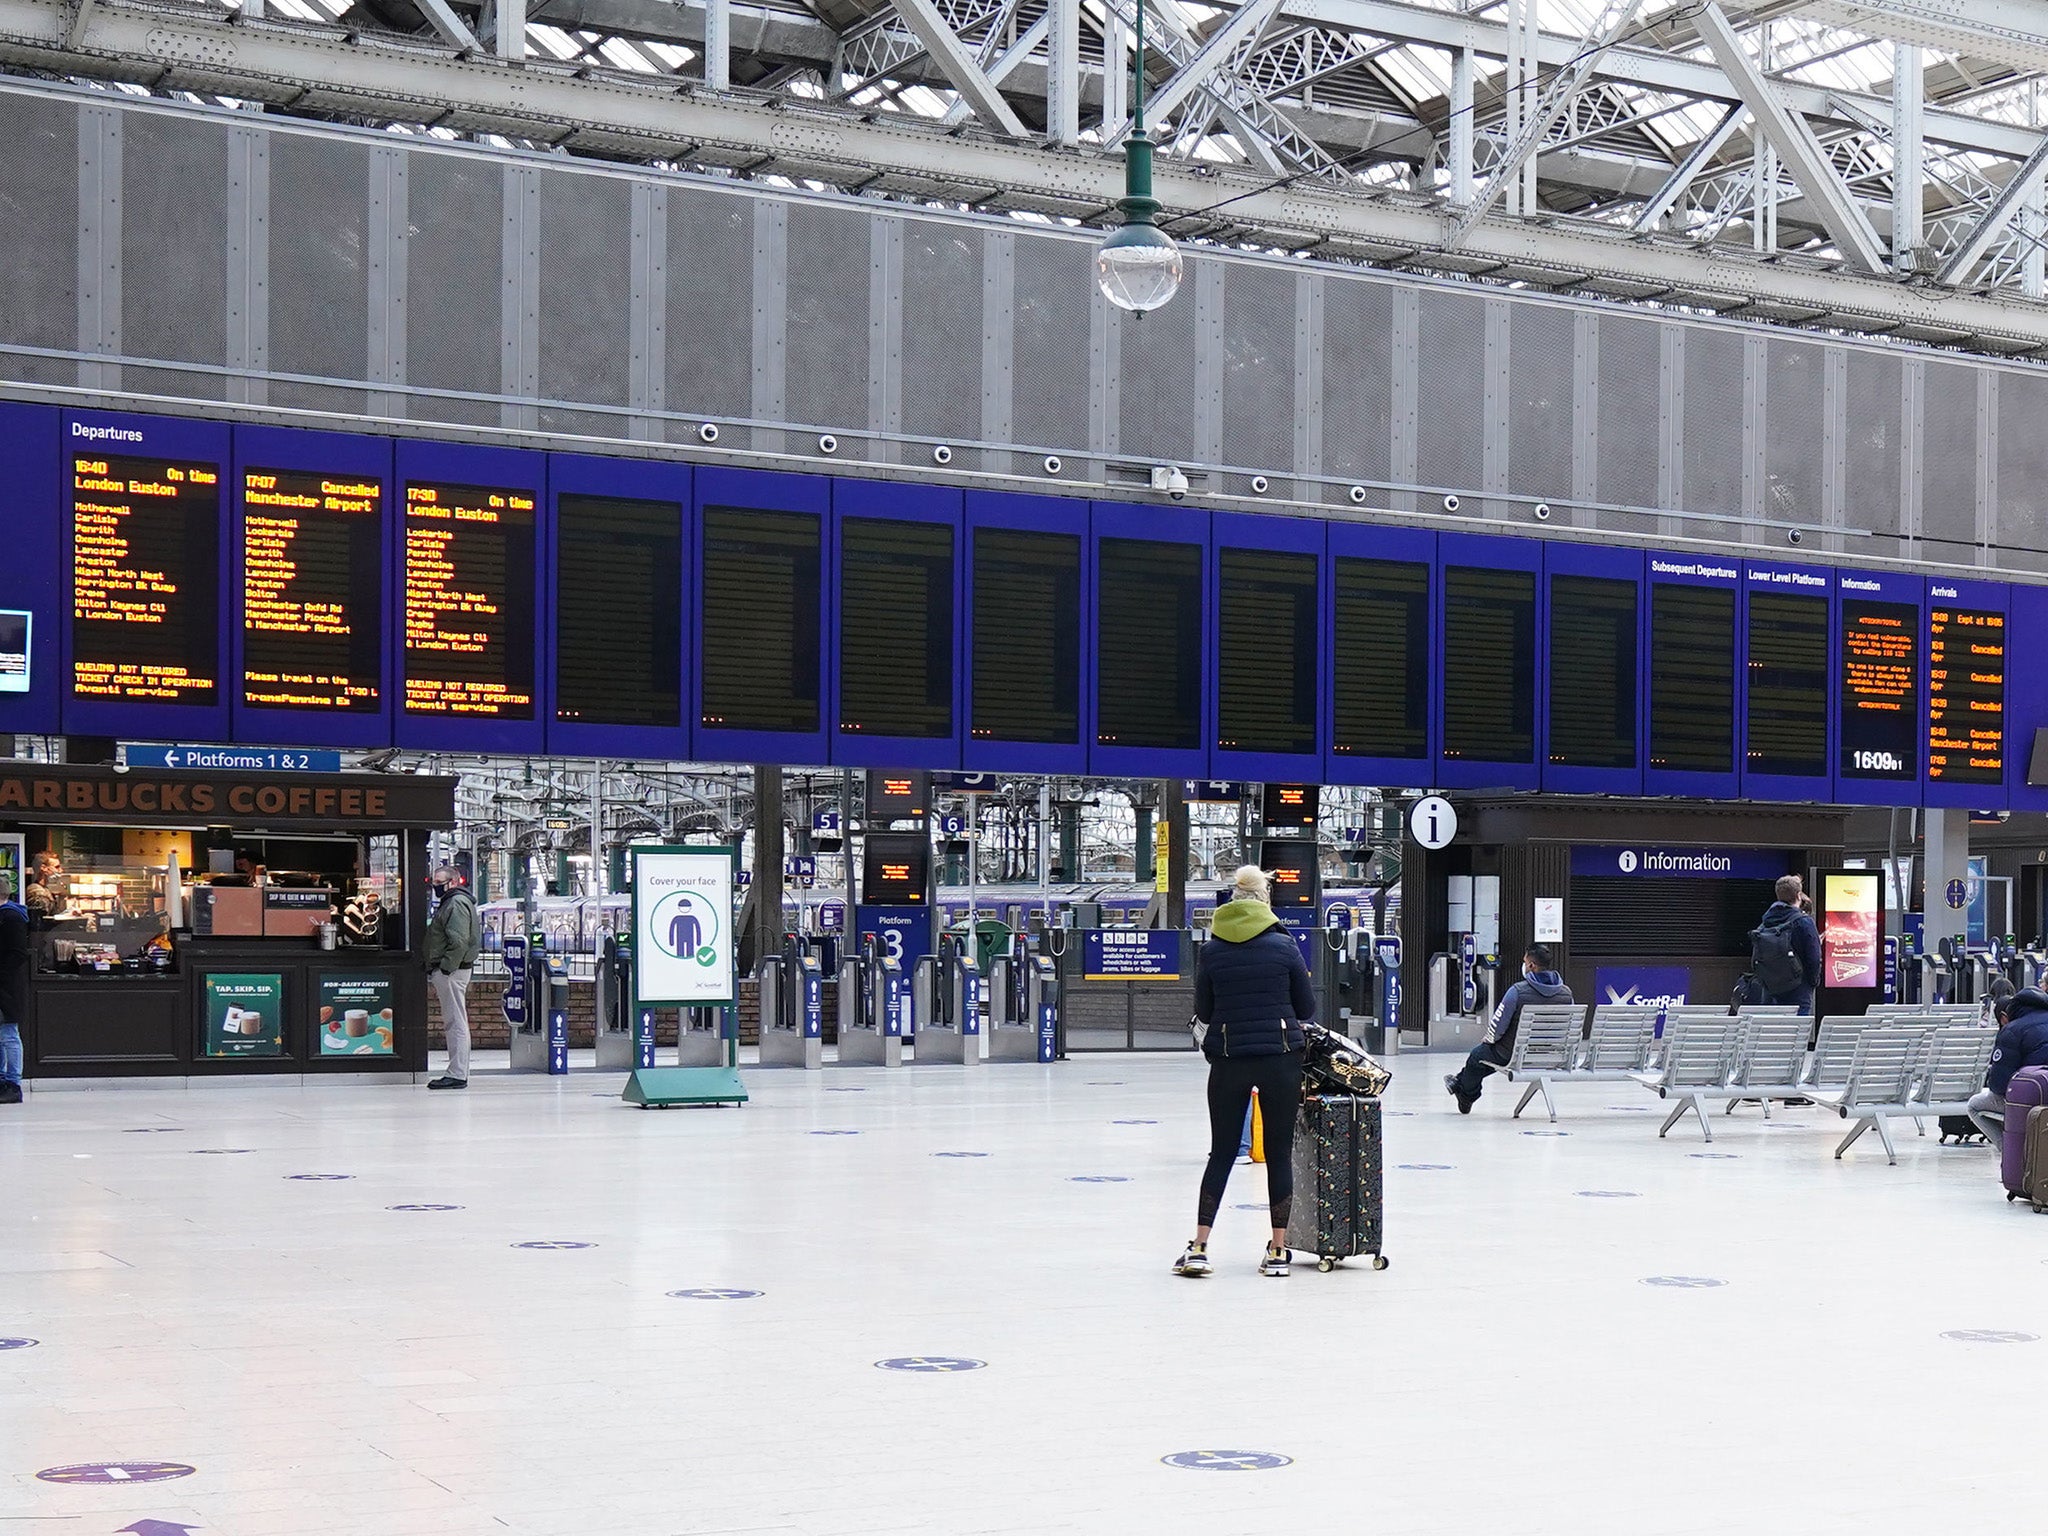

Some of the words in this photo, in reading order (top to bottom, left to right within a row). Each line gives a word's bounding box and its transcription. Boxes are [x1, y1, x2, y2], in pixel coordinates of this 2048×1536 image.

[72, 422, 143, 442] Departures
[75, 460, 108, 474] 16:40
[166, 467, 184, 481] On
[189, 469, 217, 483] time
[75, 476, 124, 492] London
[129, 480, 178, 496] Euston
[246, 475, 276, 488] 17:07
[321, 481, 379, 497] Cancelled
[246, 491, 320, 508] Manchester
[324, 497, 372, 512] Airport
[407, 488, 436, 502] 17:30
[489, 495, 504, 507] On
[508, 496, 533, 510] time
[75, 502, 131, 514] Motherwell
[407, 503, 451, 518] London
[454, 507, 498, 522] Euston
[75, 513, 118, 524] Carlisle
[245, 516, 298, 528] Motherwell
[75, 524, 115, 535] Penrith
[246, 527, 294, 538] Lockerbie
[75, 534, 128, 546] Oxenholme
[246, 537, 286, 548] Carlisle
[75, 545, 128, 556] Lancaster
[246, 547, 283, 558] Penrith
[75, 556, 116, 566] Preston
[246, 558, 296, 569] Oxenholme
[75, 567, 104, 577] Wigan
[108, 569, 137, 579] North
[141, 571, 164, 580] West
[246, 568, 296, 579] Lancaster
[1652, 560, 1696, 576] Subsequent
[1698, 565, 1736, 578] Departures
[246, 578, 285, 589] Preston
[1749, 570, 1770, 581] Lower
[1772, 572, 1791, 583] Level
[1792, 574, 1826, 586] Platforms
[1842, 578, 1880, 591] Information
[75, 588, 106, 598] Crewe
[246, 588, 278, 598] Bolton
[1931, 586, 1957, 598] Arrivals
[246, 599, 302, 610] Manchester
[86, 610, 122, 620] London
[126, 612, 162, 622] Euston
[246, 610, 302, 620] Manchester
[256, 620, 311, 632] Manchester
[314, 624, 350, 634] Airport
[1932, 624, 1944, 634] Ayr
[416, 640, 448, 650] London
[452, 642, 483, 652] Euston
[1971, 644, 2002, 655] Cancelled
[1931, 652, 1944, 662] Ayr
[75, 662, 116, 672] QUEUING
[119, 665, 137, 674] NOT
[141, 666, 187, 676] REQUIRED
[75, 673, 109, 683] TICKET
[113, 675, 144, 685] CHECK
[148, 677, 158, 686] IN
[162, 678, 212, 688] OPERATION
[246, 672, 278, 682] Please
[282, 673, 312, 684] travel
[332, 675, 348, 684] the
[1971, 673, 2002, 684] Cancelled
[75, 684, 120, 694] Avanti
[126, 686, 178, 697] service
[1930, 681, 1944, 690] Ayr
[246, 692, 331, 705] TransPennine
[336, 696, 350, 706] Ex
[406, 690, 436, 699] TICKET
[440, 691, 468, 700] CHECK
[471, 693, 480, 701] IN
[484, 694, 529, 704] OPERATION
[406, 700, 446, 710] Avanti
[452, 702, 498, 712] service
[1970, 701, 2002, 711] Cancelled
[1930, 710, 1944, 719] Ayr
[1970, 729, 2002, 740] Cancelled
[1930, 738, 1970, 749] Manchester
[1972, 741, 1997, 751] Airport
[187, 752, 263, 768] Platforms
[268, 754, 275, 768] 1
[282, 754, 295, 768] &
[299, 755, 308, 768] 2
[1854, 750, 1892, 770] 16:09
[1970, 758, 2001, 768] Cancelled
[1930, 767, 1942, 776] Ayr
[229, 786, 386, 816] COFFEE
[820, 815, 830, 828] 5
[948, 818, 958, 832] 6
[1351, 828, 1360, 840] 7
[1644, 852, 1730, 870] Information
[650, 876, 674, 886] Cover
[676, 878, 696, 888] your
[698, 877, 717, 886] face
[740, 873, 748, 883] 7
[884, 929, 904, 960] 3
[1634, 994, 1685, 1009] ScotRail
